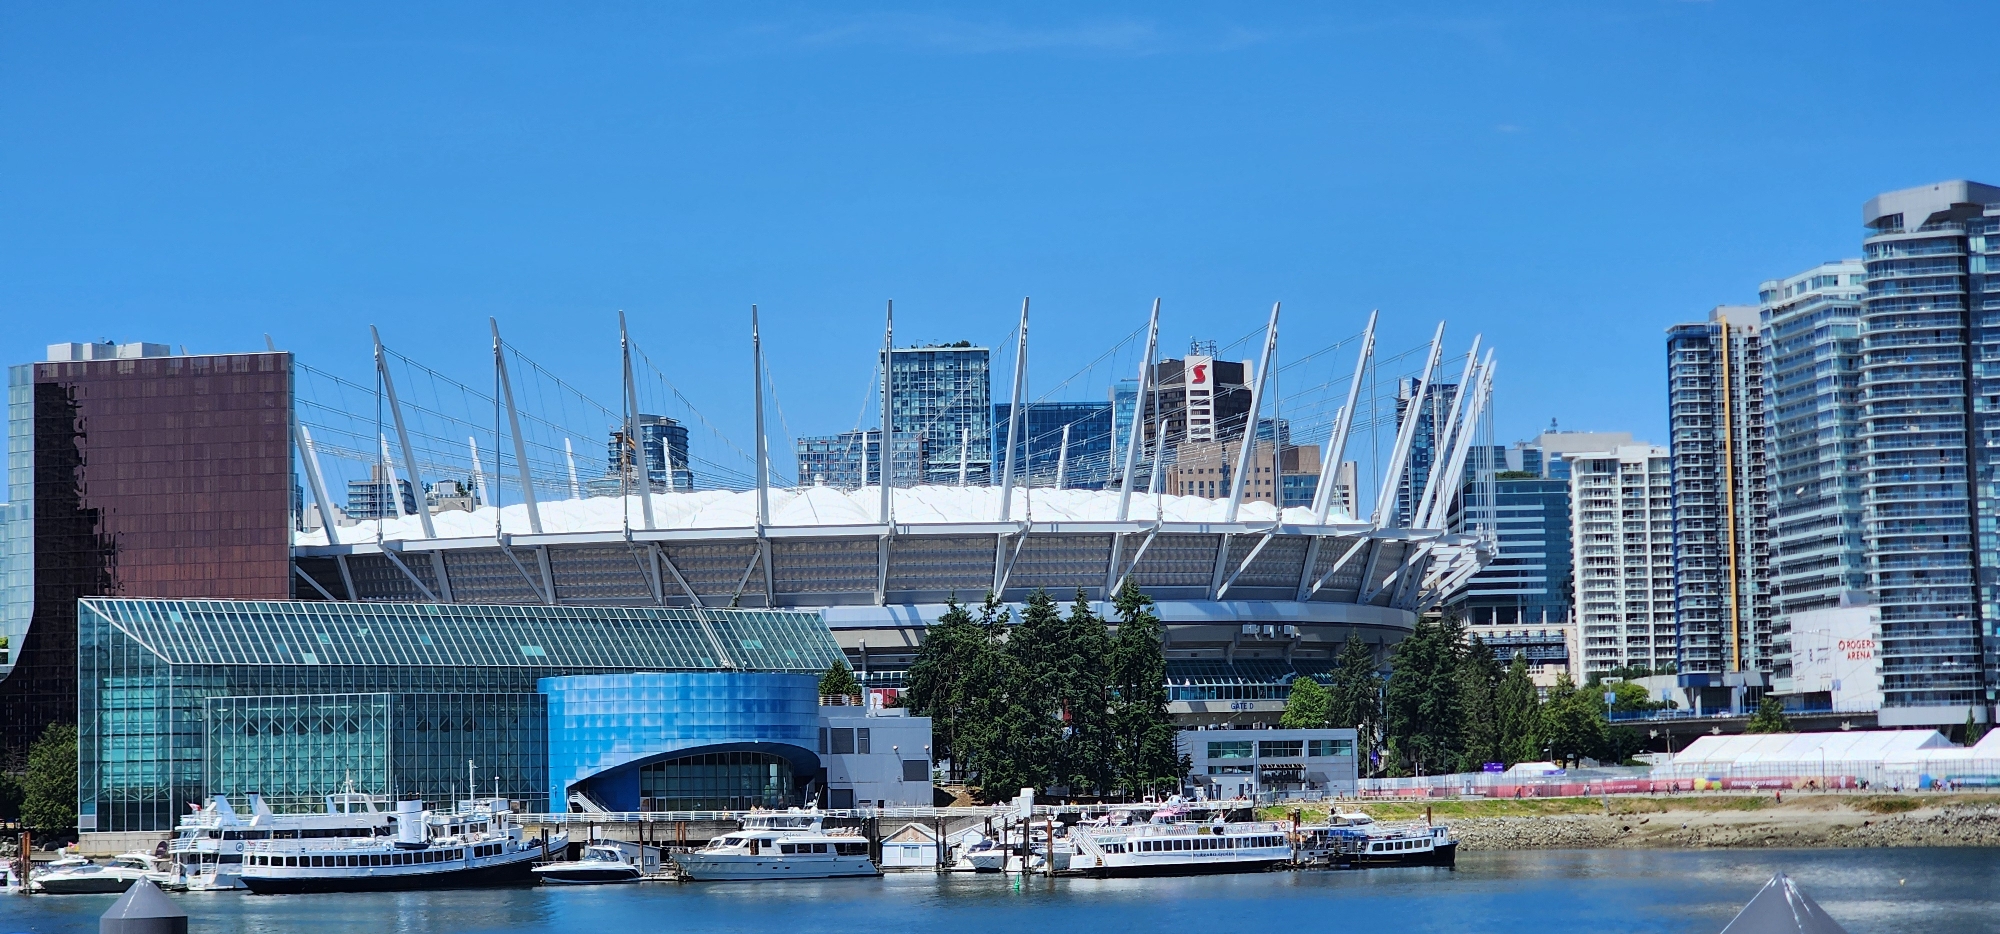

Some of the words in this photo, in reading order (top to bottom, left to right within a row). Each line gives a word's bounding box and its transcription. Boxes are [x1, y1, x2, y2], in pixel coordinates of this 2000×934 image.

[1846, 640, 1876, 650] ROGERS
[1847, 651, 1872, 660] ARENA
[1230, 702, 1248, 710] GATE
[1249, 702, 1254, 710] D
